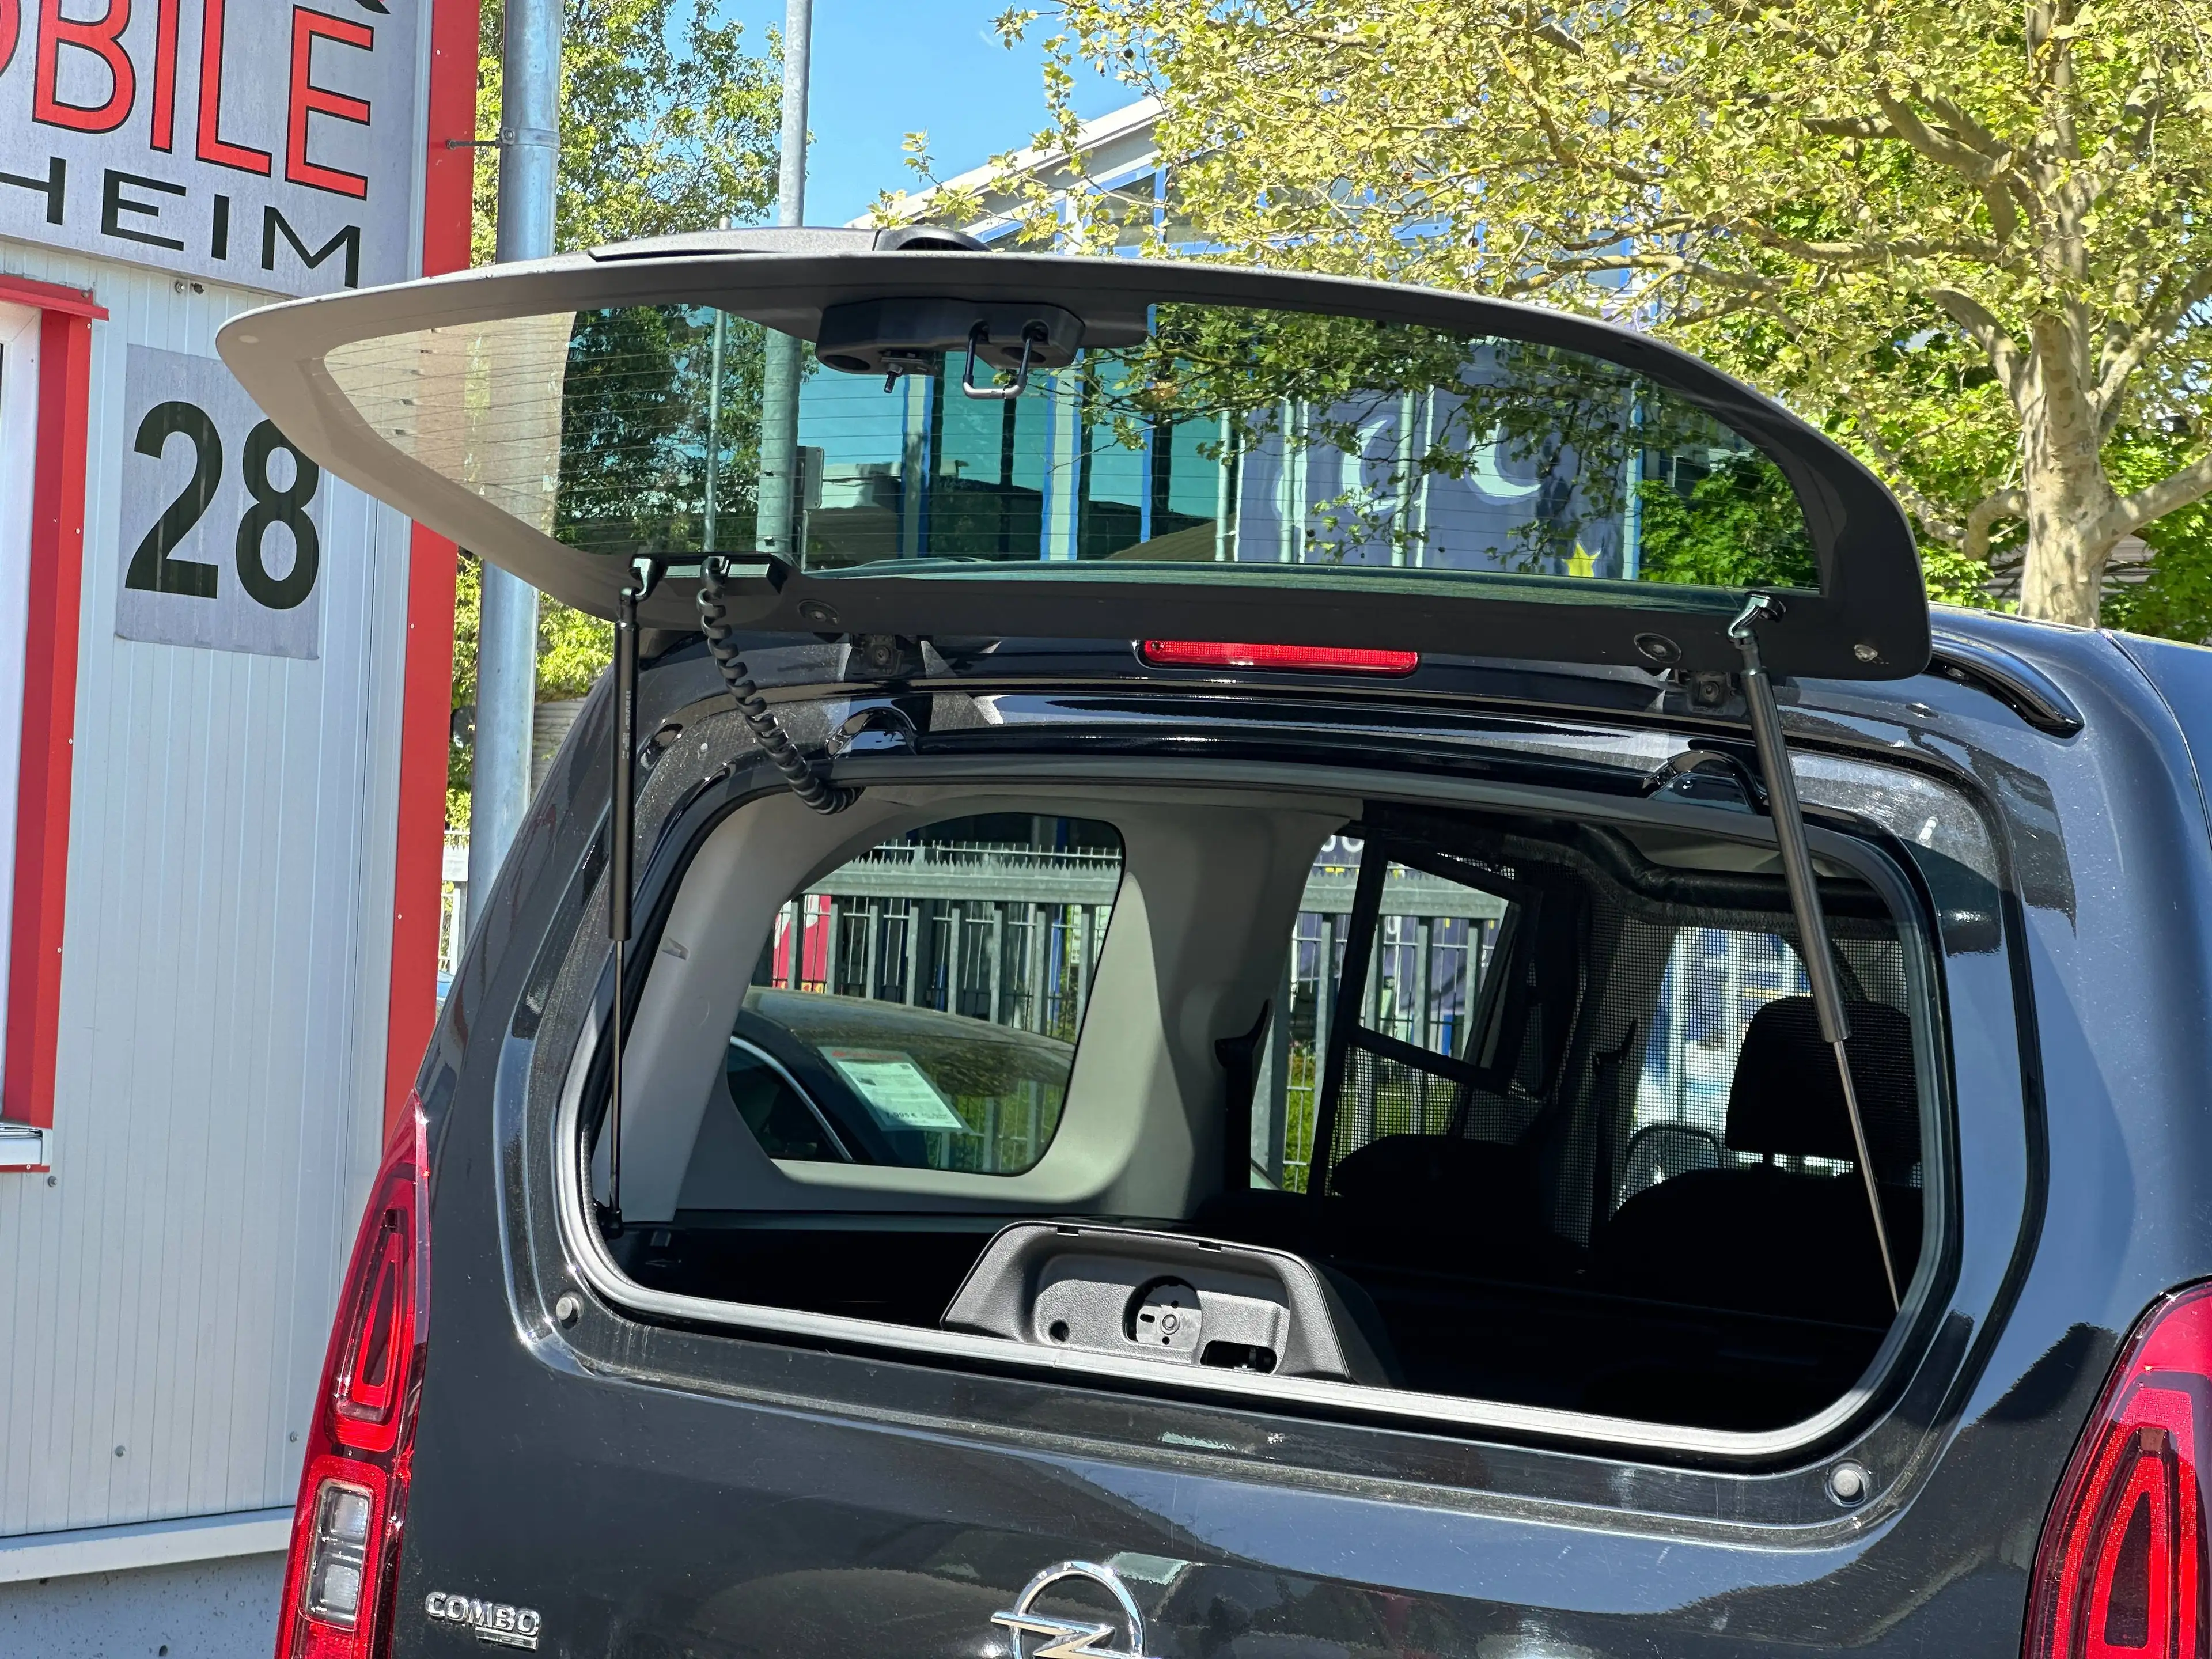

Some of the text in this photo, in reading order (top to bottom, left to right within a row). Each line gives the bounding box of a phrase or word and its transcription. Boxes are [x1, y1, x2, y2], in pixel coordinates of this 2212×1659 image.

[0, 0, 374, 201] BILE
[125, 401, 320, 610] 28
[425, 1592, 541, 1635] COMBO
